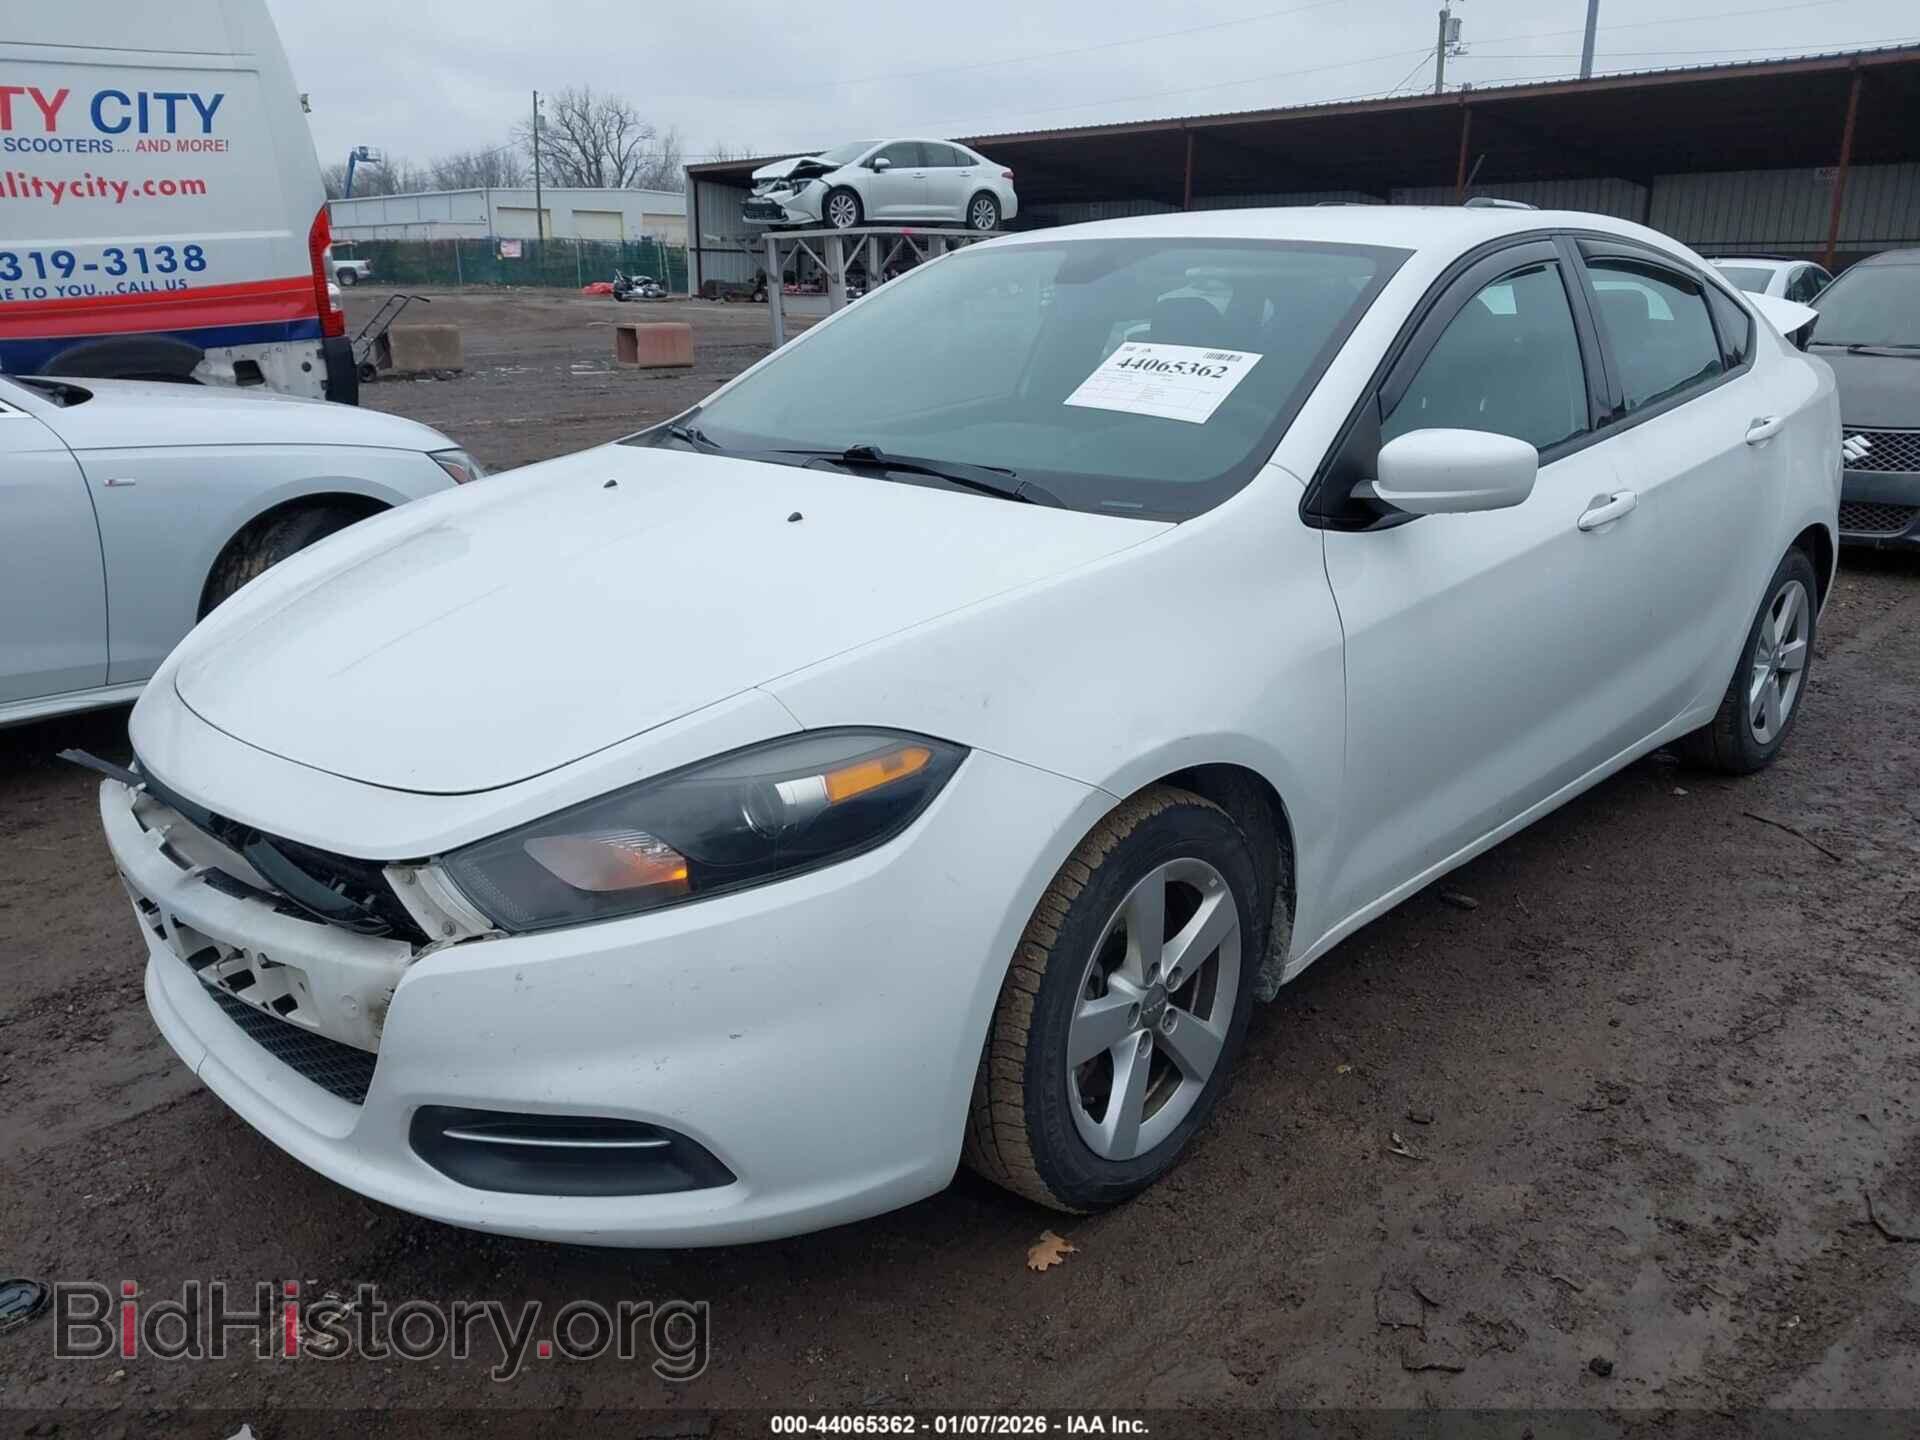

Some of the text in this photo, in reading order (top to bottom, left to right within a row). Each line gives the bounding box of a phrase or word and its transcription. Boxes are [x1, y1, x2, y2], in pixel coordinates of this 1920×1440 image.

[90, 89, 225, 134] CITY
[135, 139, 171, 152] AND
[176, 139, 229, 152] MORE!
[0, 245, 207, 281] 319-3138
[0, 288, 14, 300] E
[21, 286, 47, 299] TO
[165, 279, 188, 290] US
[1117, 357, 1229, 379] 44065362
